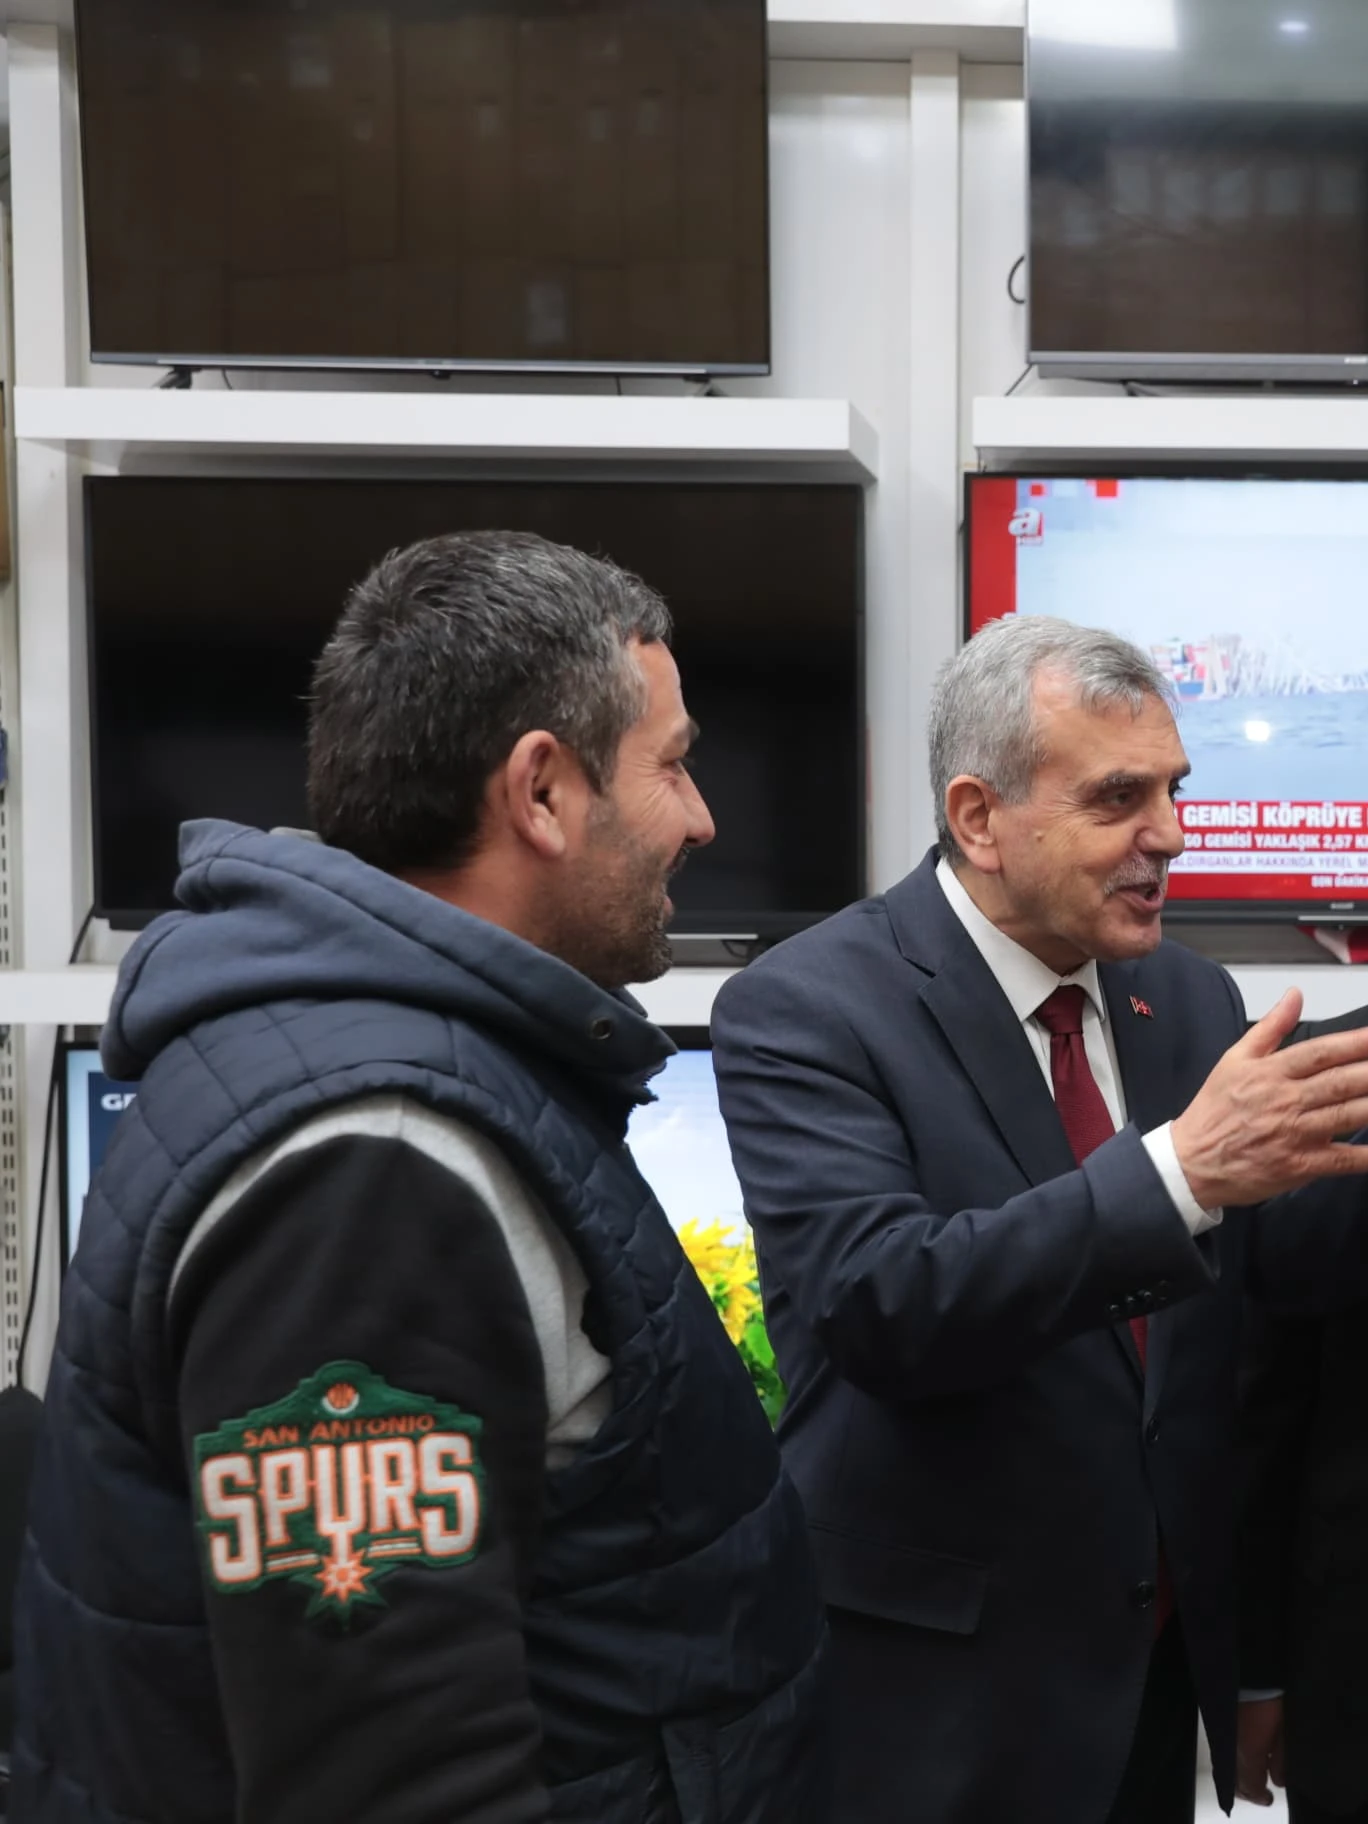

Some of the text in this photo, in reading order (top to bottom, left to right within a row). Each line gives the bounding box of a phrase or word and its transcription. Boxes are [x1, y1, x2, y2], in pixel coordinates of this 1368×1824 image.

[1183, 801, 1257, 828] GEMİSİ
[1262, 801, 1362, 828] KÖPRÜYE
[1204, 830, 1251, 848] GEMİSİ
[1254, 833, 1320, 851] YAKLAŞIK
[1321, 834, 1353, 850] 2,57
[243, 1414, 436, 1448] SAN ANTONIO
[201, 1432, 480, 1584] SPURS
